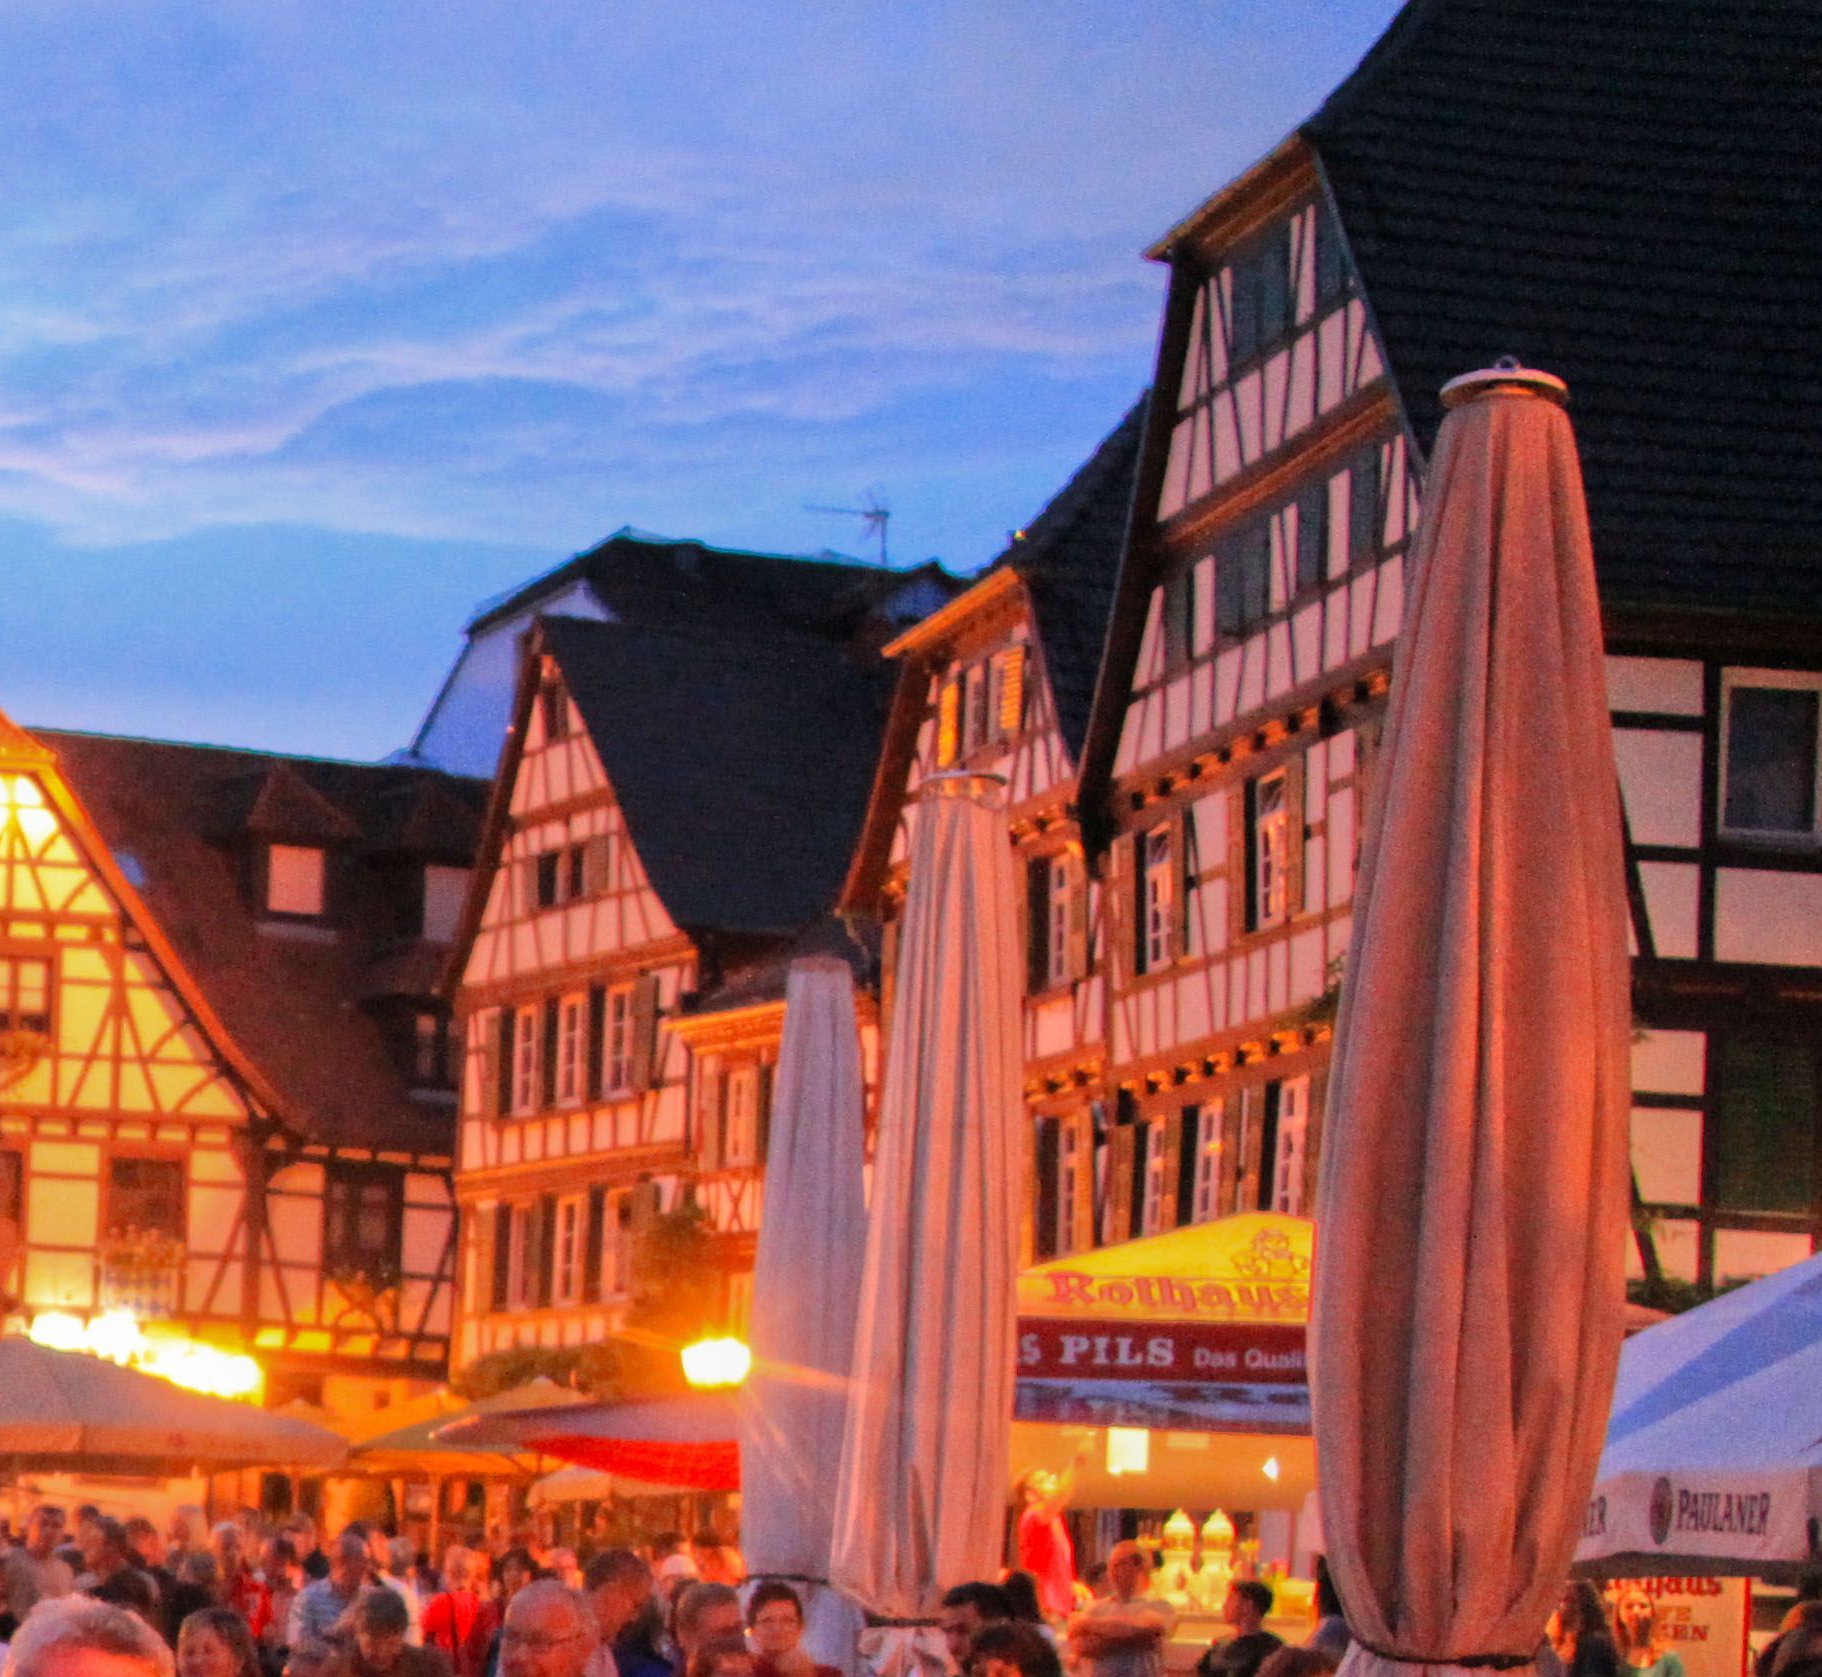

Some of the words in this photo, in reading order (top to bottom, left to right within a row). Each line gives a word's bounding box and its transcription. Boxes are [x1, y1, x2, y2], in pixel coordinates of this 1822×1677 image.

[1046, 1271, 1309, 1316] Rothaus
[1059, 1335, 1175, 1367] PILS
[1677, 1489, 1771, 1536] PAULANER
